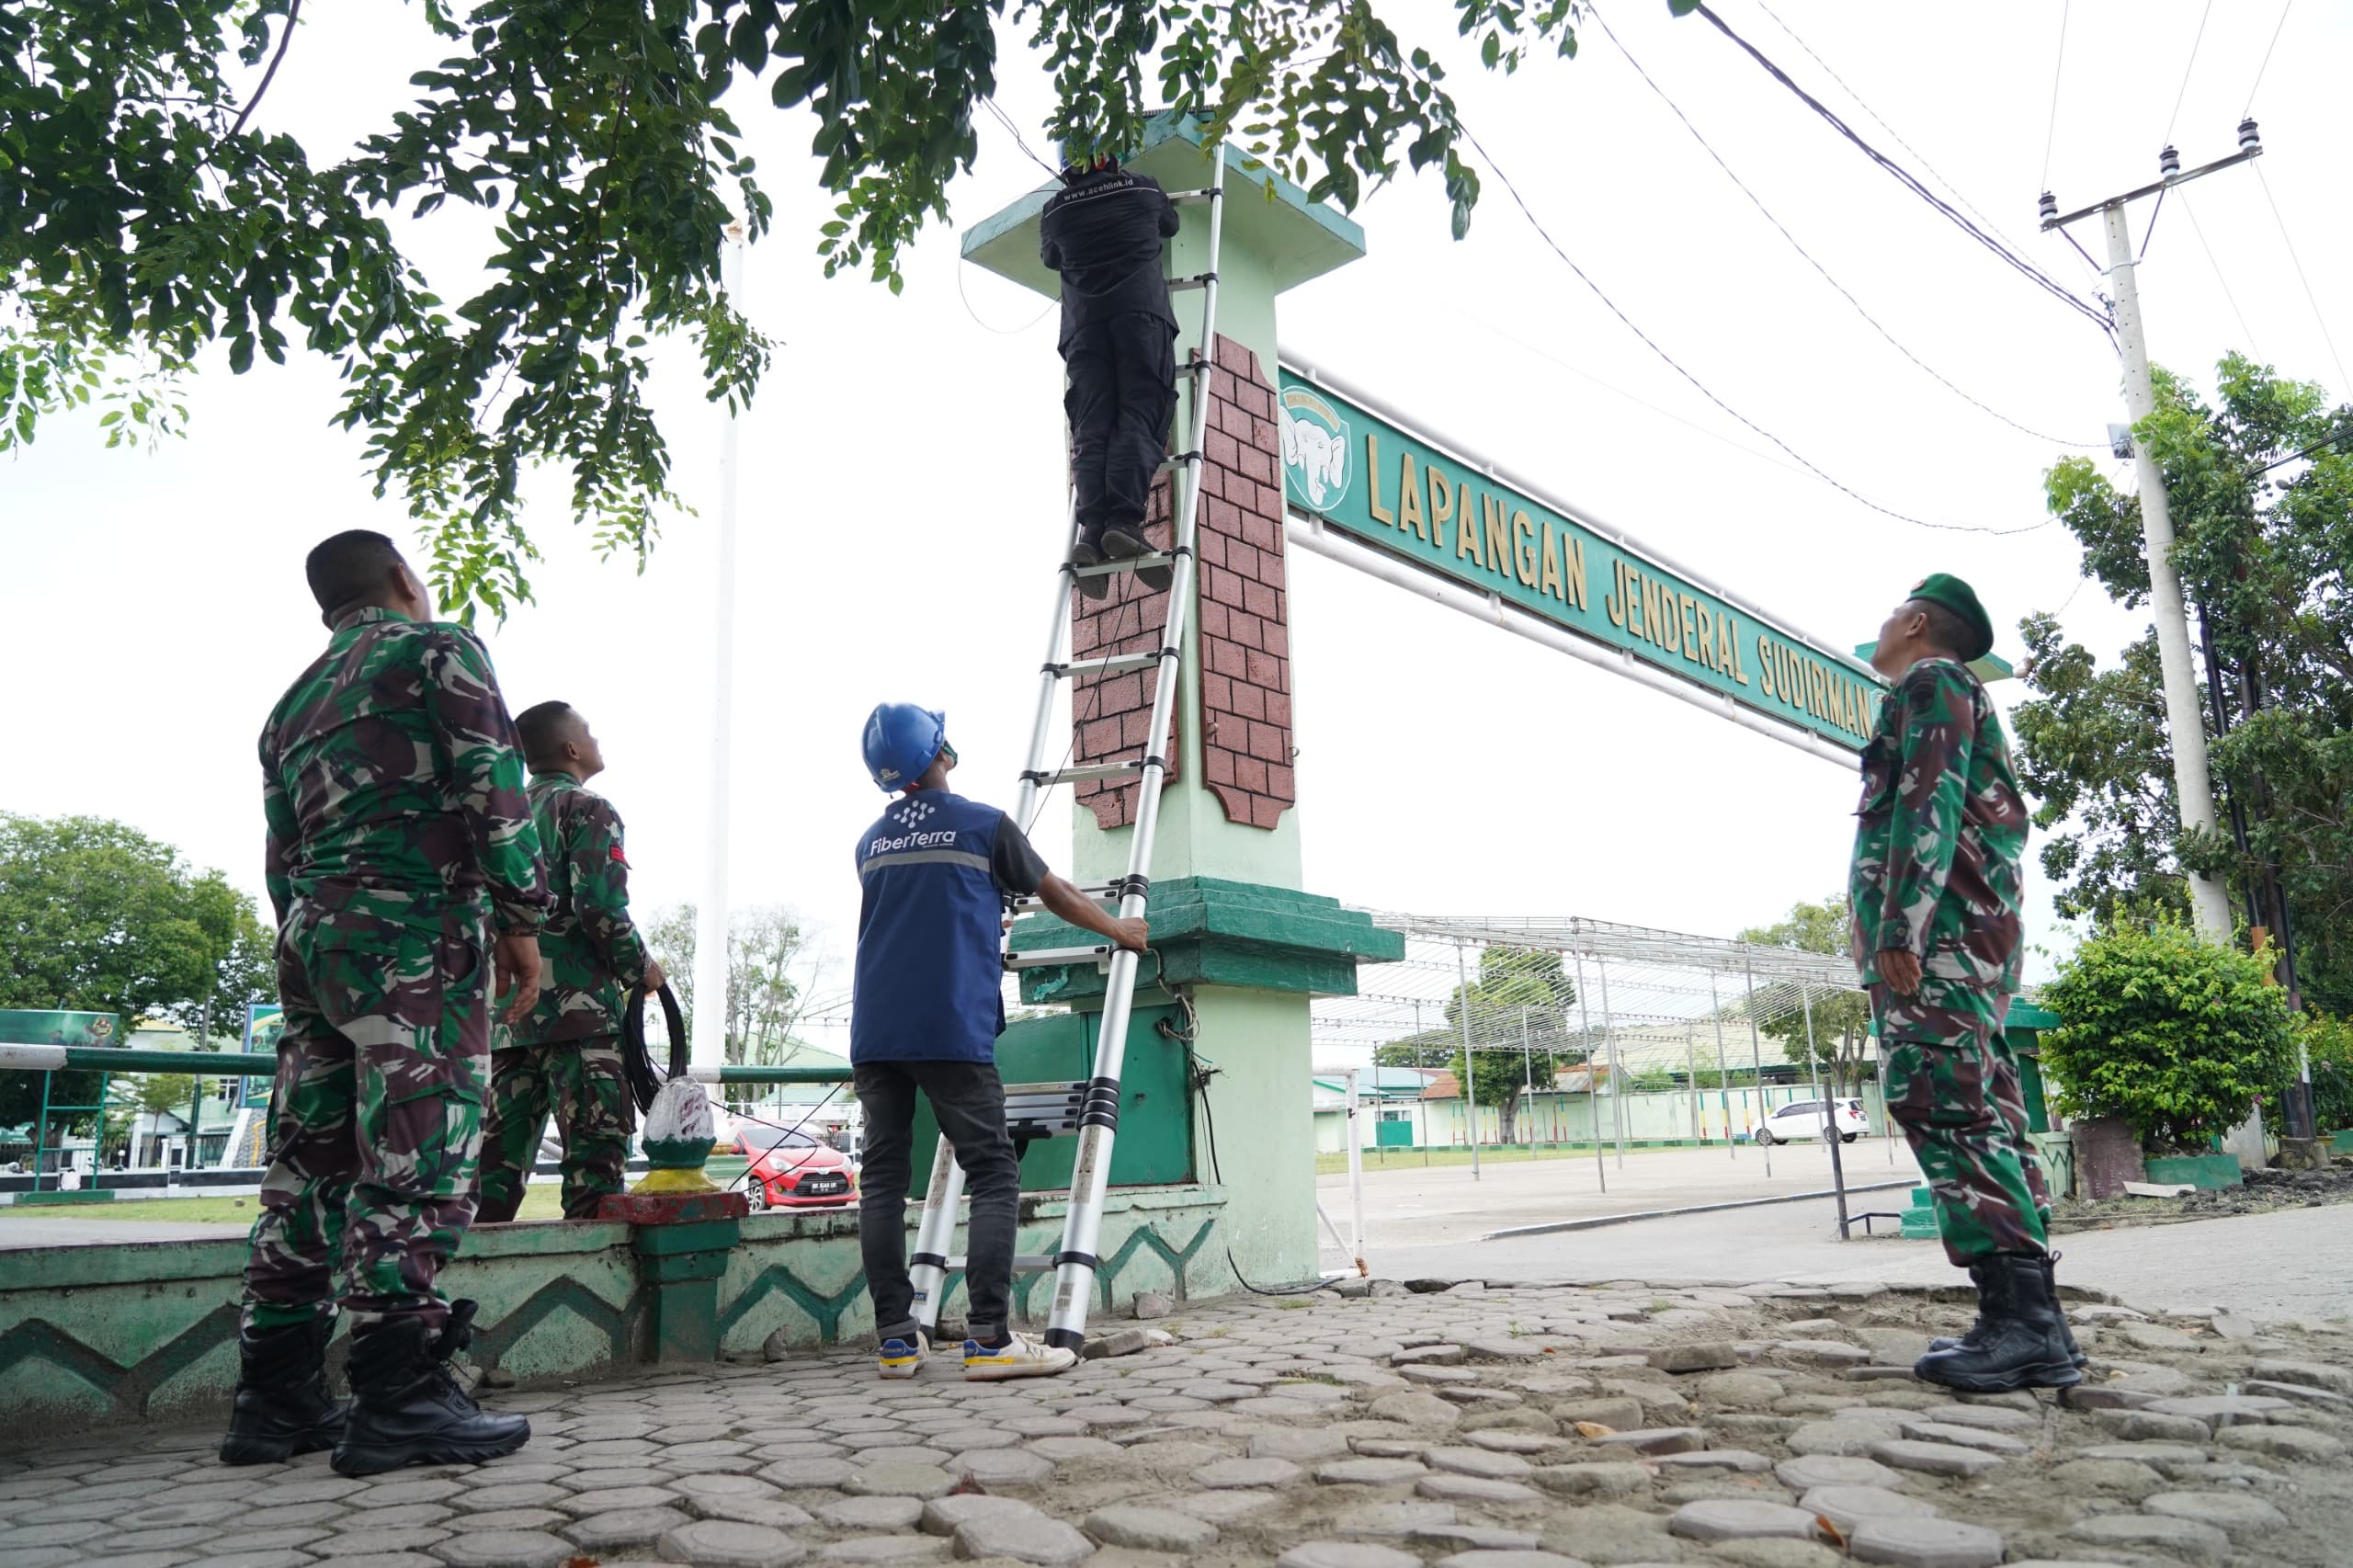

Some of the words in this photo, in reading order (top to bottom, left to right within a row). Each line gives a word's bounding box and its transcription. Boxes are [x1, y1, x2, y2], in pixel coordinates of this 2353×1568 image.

[1063, 178, 1133, 201] www.acehlink.id
[1366, 433, 1587, 611] LAPANGAN
[1606, 558, 1748, 686] JENDERAL
[1757, 634, 1873, 741] SUDIRMAN
[870, 830, 957, 857] FiberTerra
